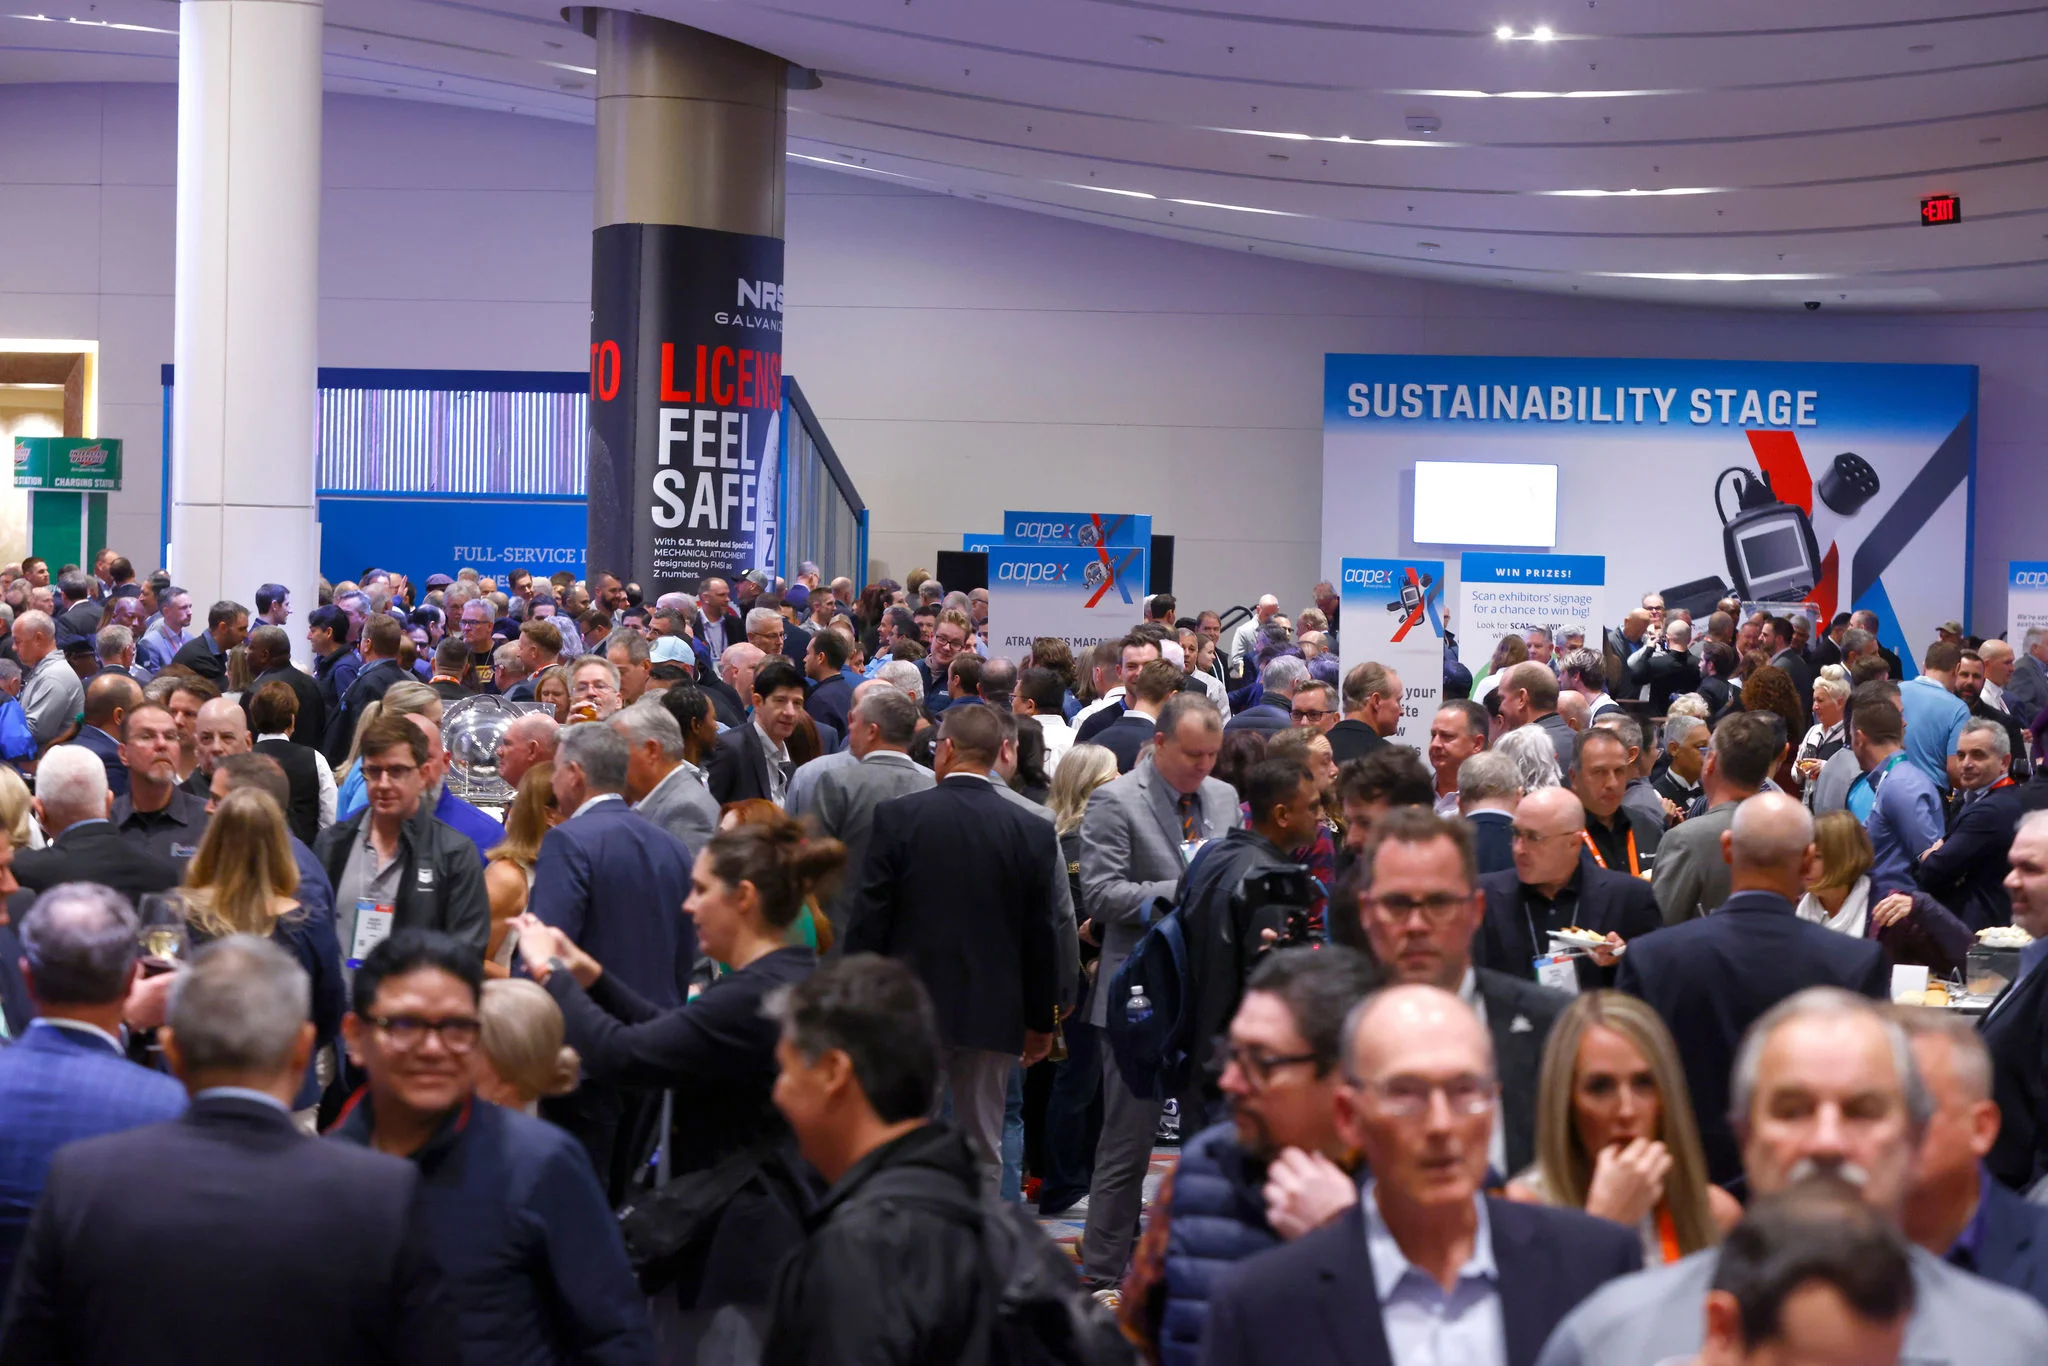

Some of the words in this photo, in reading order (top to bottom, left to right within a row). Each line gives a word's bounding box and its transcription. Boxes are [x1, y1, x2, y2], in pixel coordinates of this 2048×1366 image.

[1928, 199, 1954, 221] EXIT
[1348, 383, 1677, 423] SUSTAINABILITY
[1690, 388, 1818, 426] STAGE
[658, 408, 755, 470] FEEL
[55, 478, 92, 487] CHARGING
[651, 469, 756, 531] SAFE
[1015, 522, 1075, 543] aapex
[654, 537, 676, 546] With
[678, 538, 694, 546] O.E.
[696, 539, 719, 548] Tested
[720, 541, 731, 549] and
[453, 546, 576, 563] FULL-SERVICE
[654, 548, 708, 558] MECHANICAL
[709, 550, 746, 560] ATTACHMENT
[653, 559, 699, 569] designated
[701, 562, 709, 570] by
[710, 561, 726, 569] FMSI
[653, 570, 660, 578] Z
[662, 571, 700, 579] numbers.
[998, 562, 1070, 586] aapex
[1345, 568, 1393, 588] aapex
[1496, 567, 1521, 577] WIN
[1526, 568, 1572, 578] PRIZES!
[2016, 571, 2048, 589] aap
[1472, 591, 1496, 601] Scan
[1553, 593, 1592, 606] signage
[1473, 604, 1488, 613] for
[1491, 606, 1497, 614] a
[1500, 604, 1536, 615] chance
[1538, 606, 1549, 616] to
[1551, 606, 1569, 616] win
[1571, 606, 1590, 619] big!
[1477, 620, 1495, 629] Look
[1498, 620, 1508, 629] for
[1405, 687, 1437, 700] your
